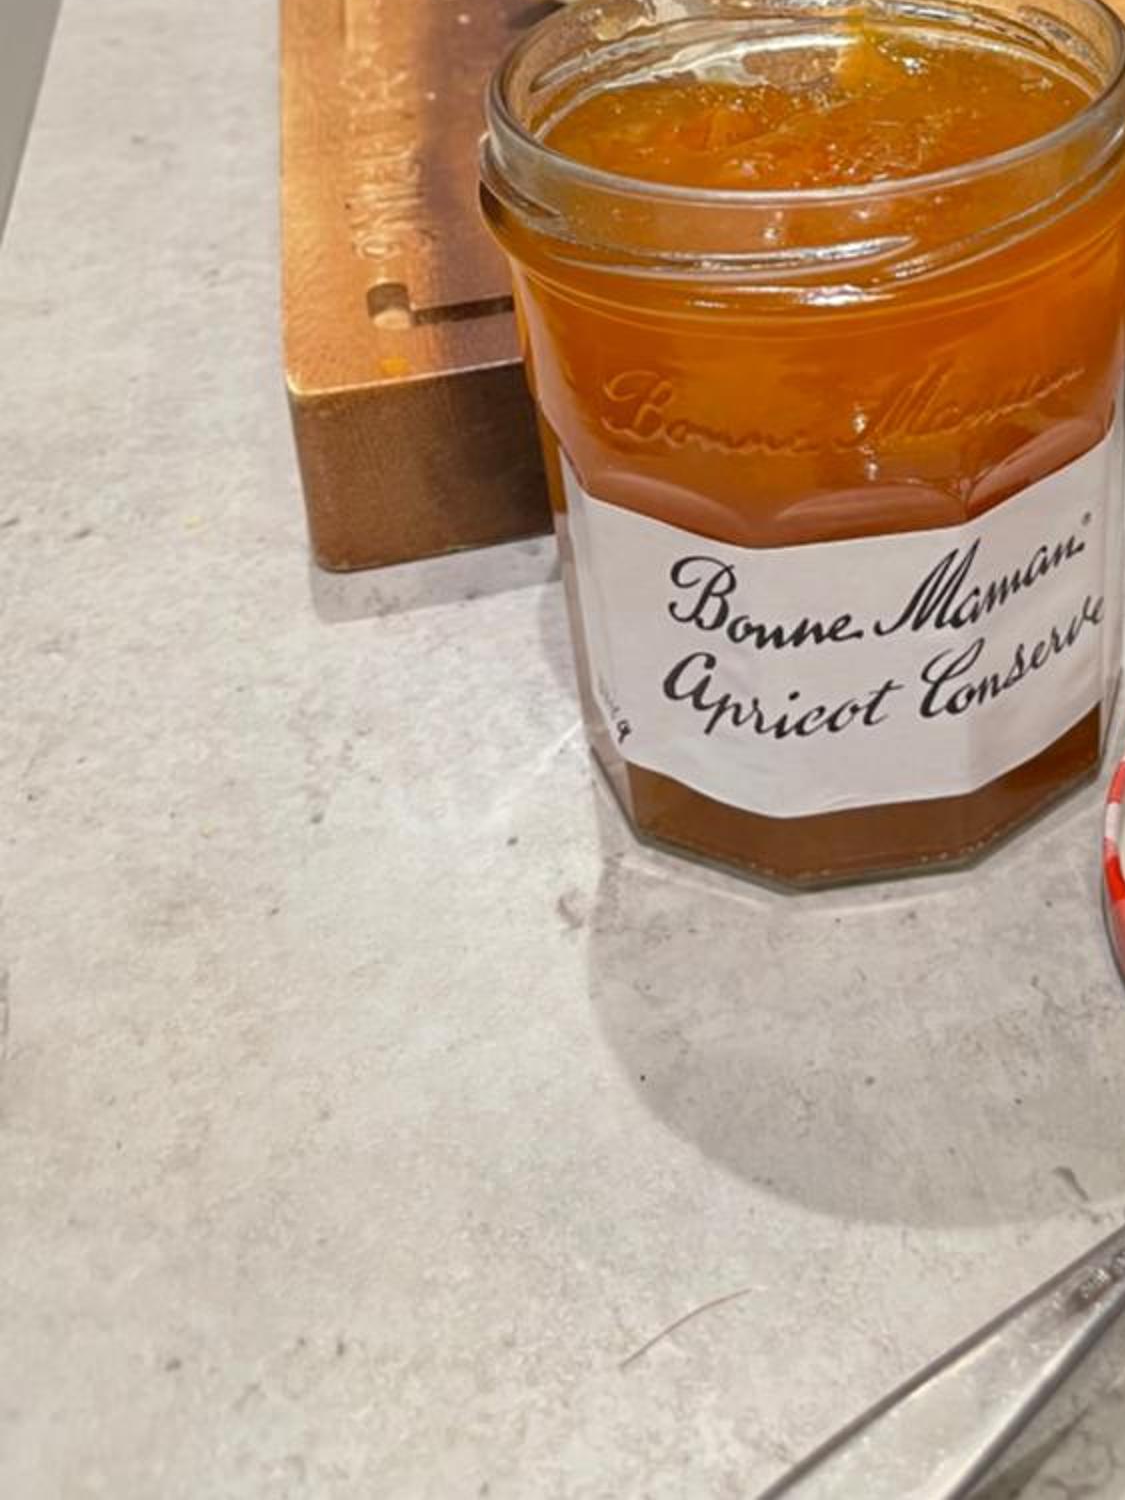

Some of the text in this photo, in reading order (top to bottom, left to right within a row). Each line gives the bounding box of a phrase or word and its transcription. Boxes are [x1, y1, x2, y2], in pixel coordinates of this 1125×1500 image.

[600, 369, 820, 457] Bonne
[667, 537, 1087, 650] Bonne Maman
[662, 651, 905, 740] Apricot
